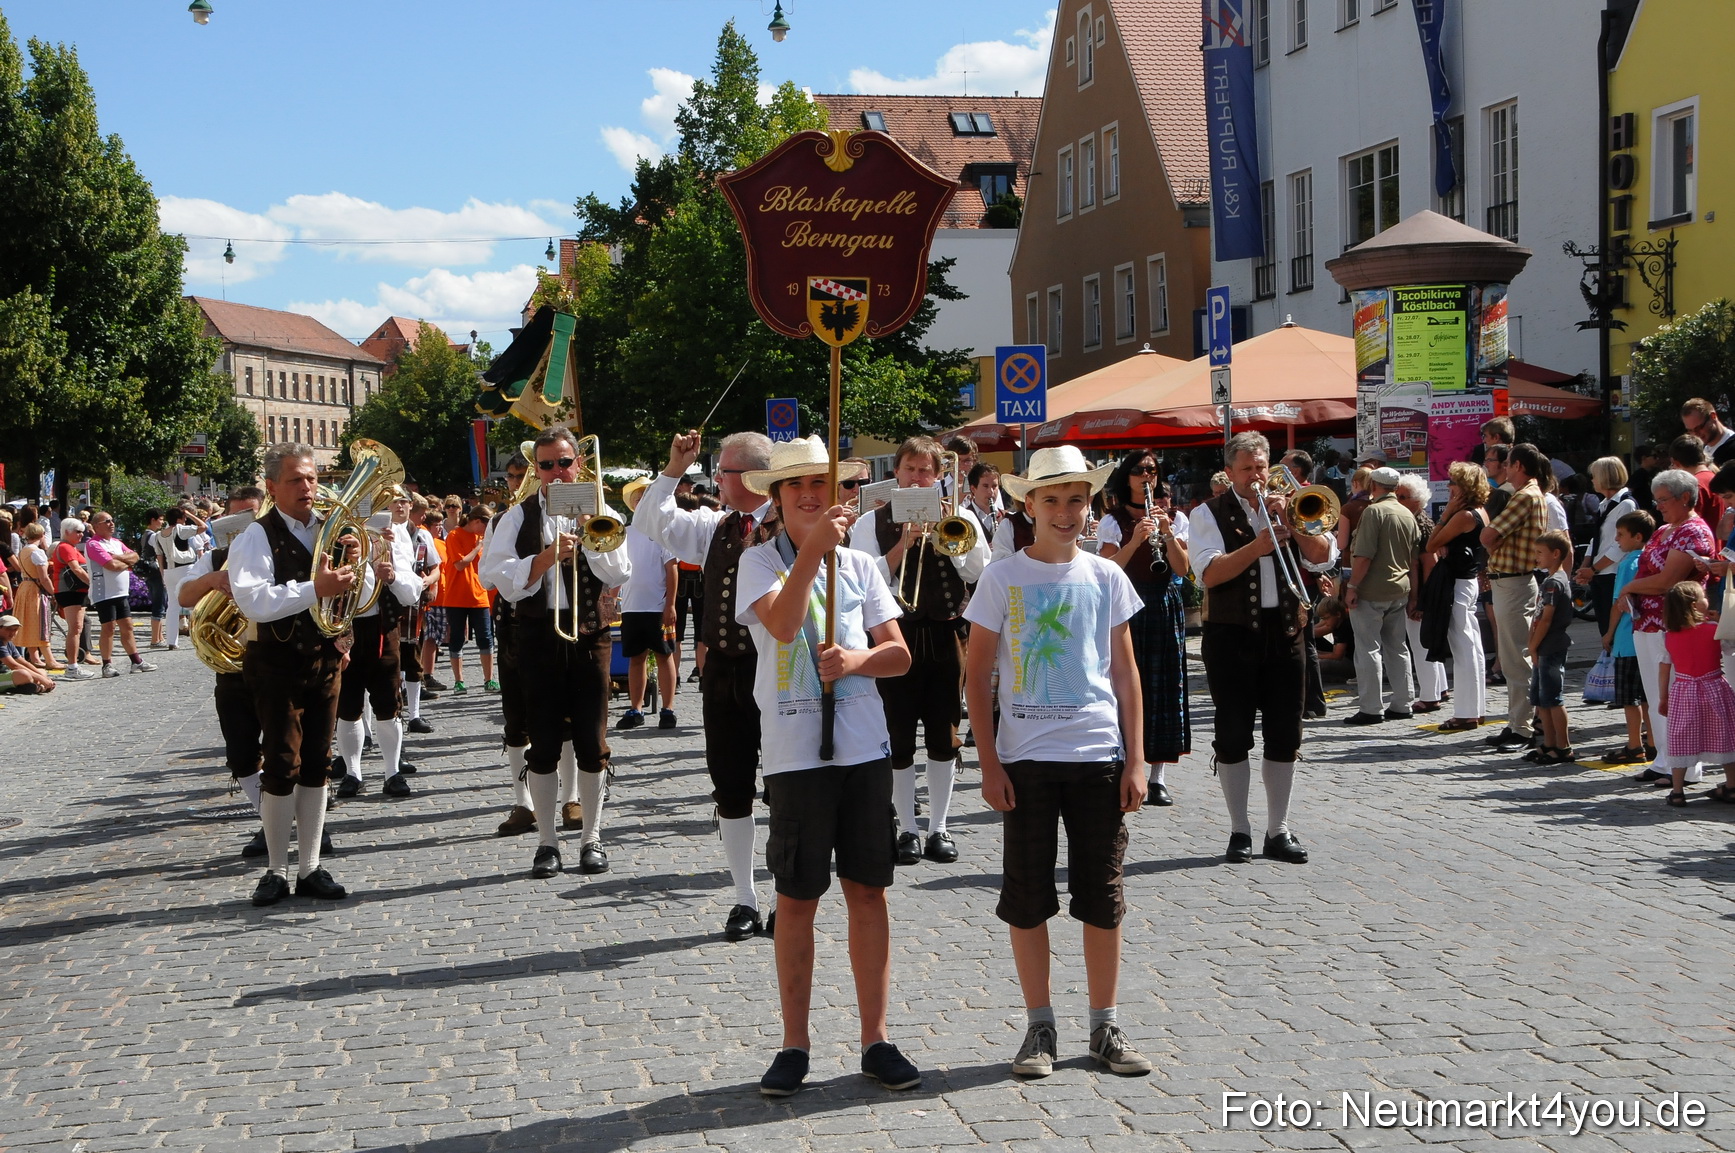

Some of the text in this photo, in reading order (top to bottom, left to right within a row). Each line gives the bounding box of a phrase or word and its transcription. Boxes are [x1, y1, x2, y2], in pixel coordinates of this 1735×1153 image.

[759, 185, 918, 221] Blaskapelle
[781, 220, 894, 257] Berngau
[786, 282, 891, 297] 19 73
[1396, 290, 1461, 302] Jacobikirwa
[1402, 300, 1456, 312] Köstlbach
[1211, 295, 1226, 340] P
[1001, 400, 1041, 417] TAXI
[1431, 401, 1455, 410] ANDY
[1458, 399, 1490, 408] WARHOL
[1508, 400, 1567, 414] ehmeier
[770, 430, 796, 441] TAXI
[1008, 586, 1021, 634] PORTO
[777, 640, 789, 692] LEGRE
[1011, 638, 1023, 695] ALEGRE
